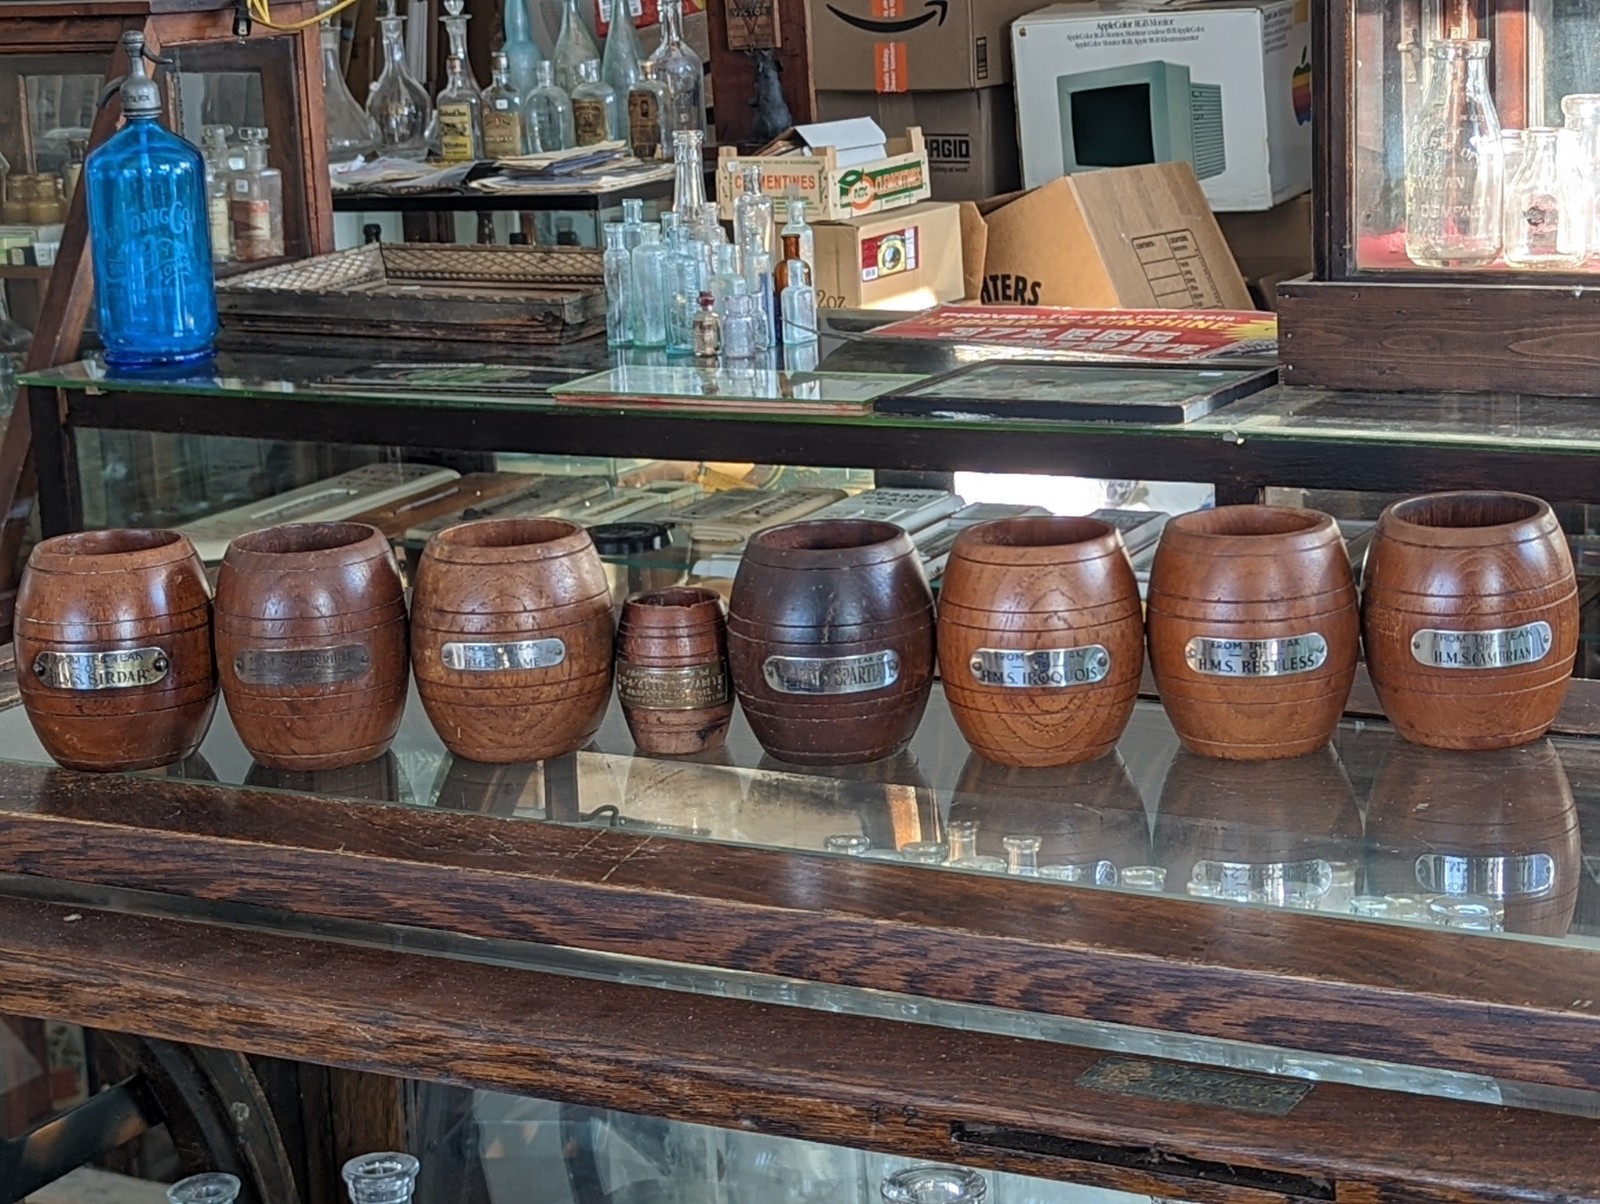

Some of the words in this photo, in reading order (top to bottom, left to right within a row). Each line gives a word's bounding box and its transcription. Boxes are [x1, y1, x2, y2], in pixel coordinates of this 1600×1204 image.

[732, 7, 767, 17] VICTOR
[1096, 21, 1132, 32] AppleColor
[925, 139, 970, 158] AGID
[735, 174, 816, 190] CMENTINES
[1079, 318, 1230, 331] SUNSHINE
[1433, 632, 1467, 643] FROM
[1471, 633, 1496, 643] THE
[1504, 628, 1532, 641] TEAK
[1210, 641, 1243, 650] FROM
[1249, 641, 1267, 650] THE
[1475, 643, 1493, 653] OF
[994, 652, 1025, 661] FROM
[1249, 651, 1265, 660] OF
[1198, 658, 1237, 673] H.M.S.
[1242, 654, 1315, 673] RESTLESS
[88, 670, 148, 686] SIRDAR
[1022, 666, 1098, 685] IROQUOIS
